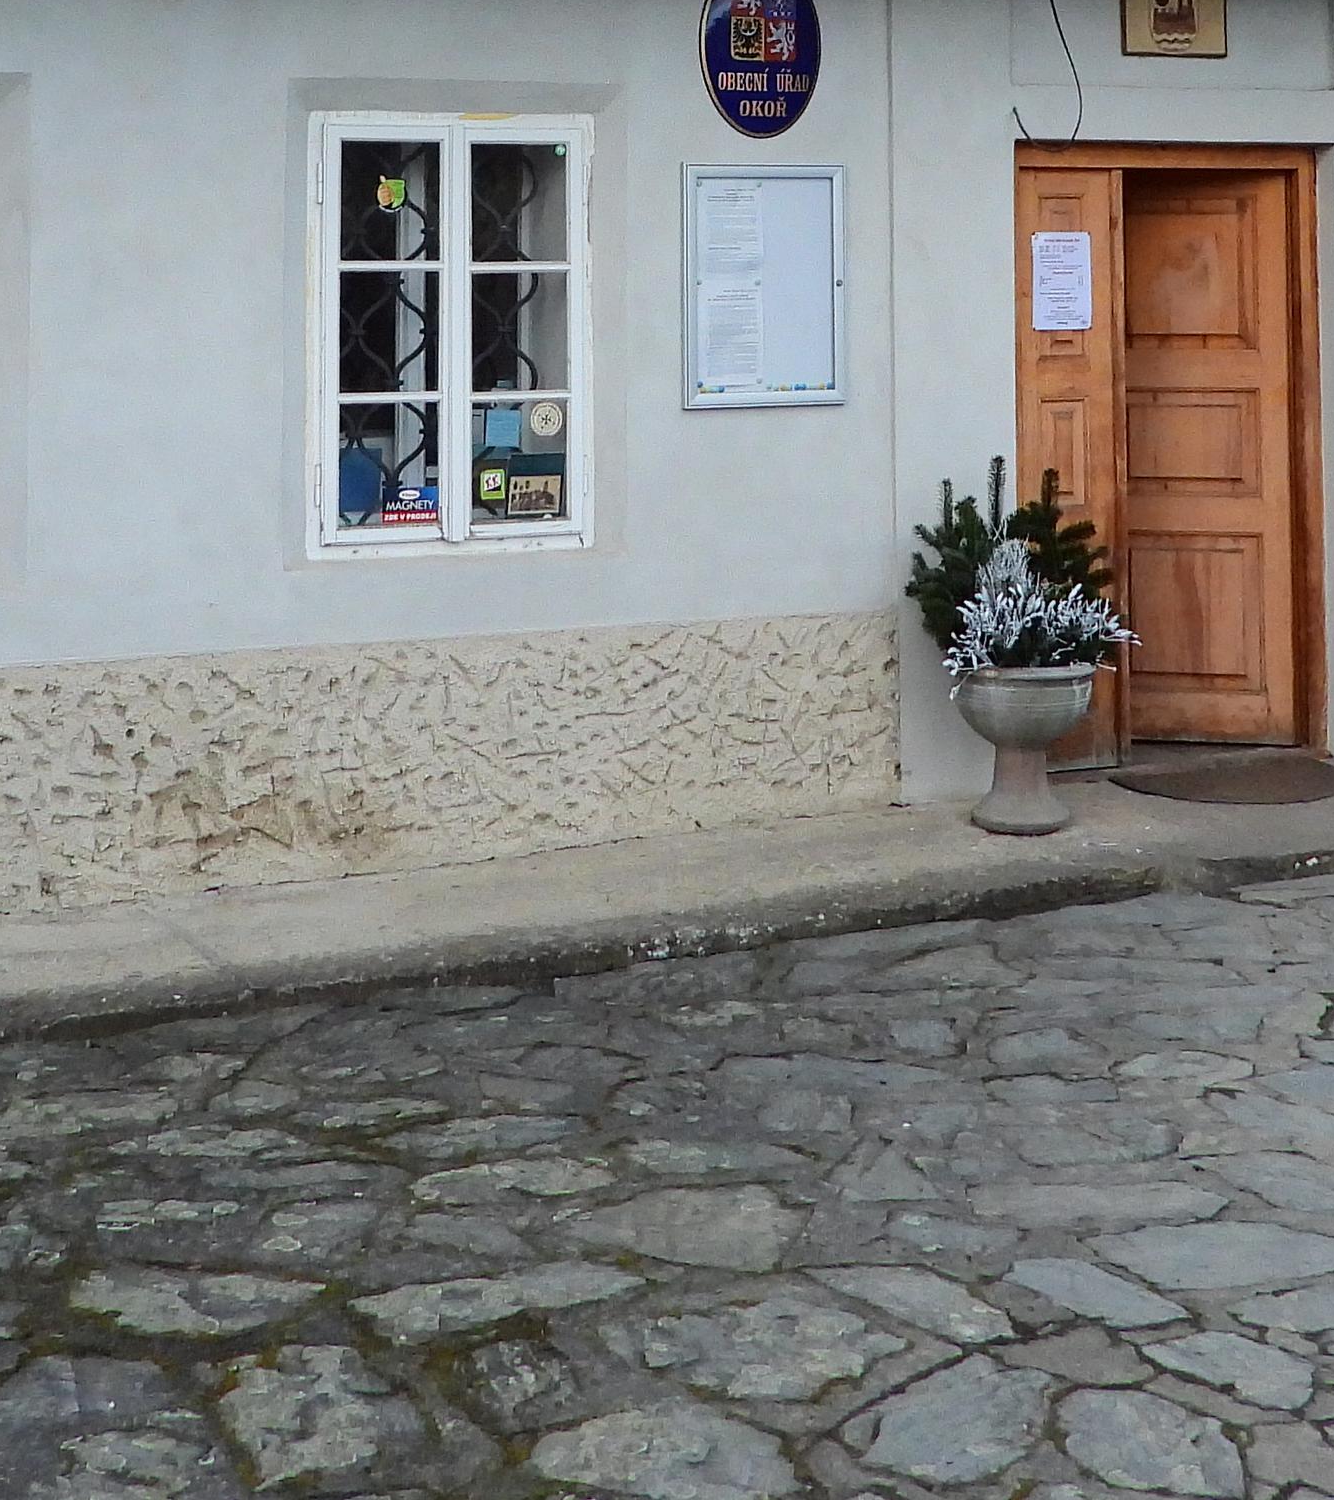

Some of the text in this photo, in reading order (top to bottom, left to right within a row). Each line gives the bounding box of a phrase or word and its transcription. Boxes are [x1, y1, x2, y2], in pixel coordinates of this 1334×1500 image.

[718, 67, 810, 93] OBECNÍ ÚŘAD
[739, 96, 787, 117] OKOŘ
[385, 499, 434, 511] MAGNETY
[400, 512, 405, 520] V
